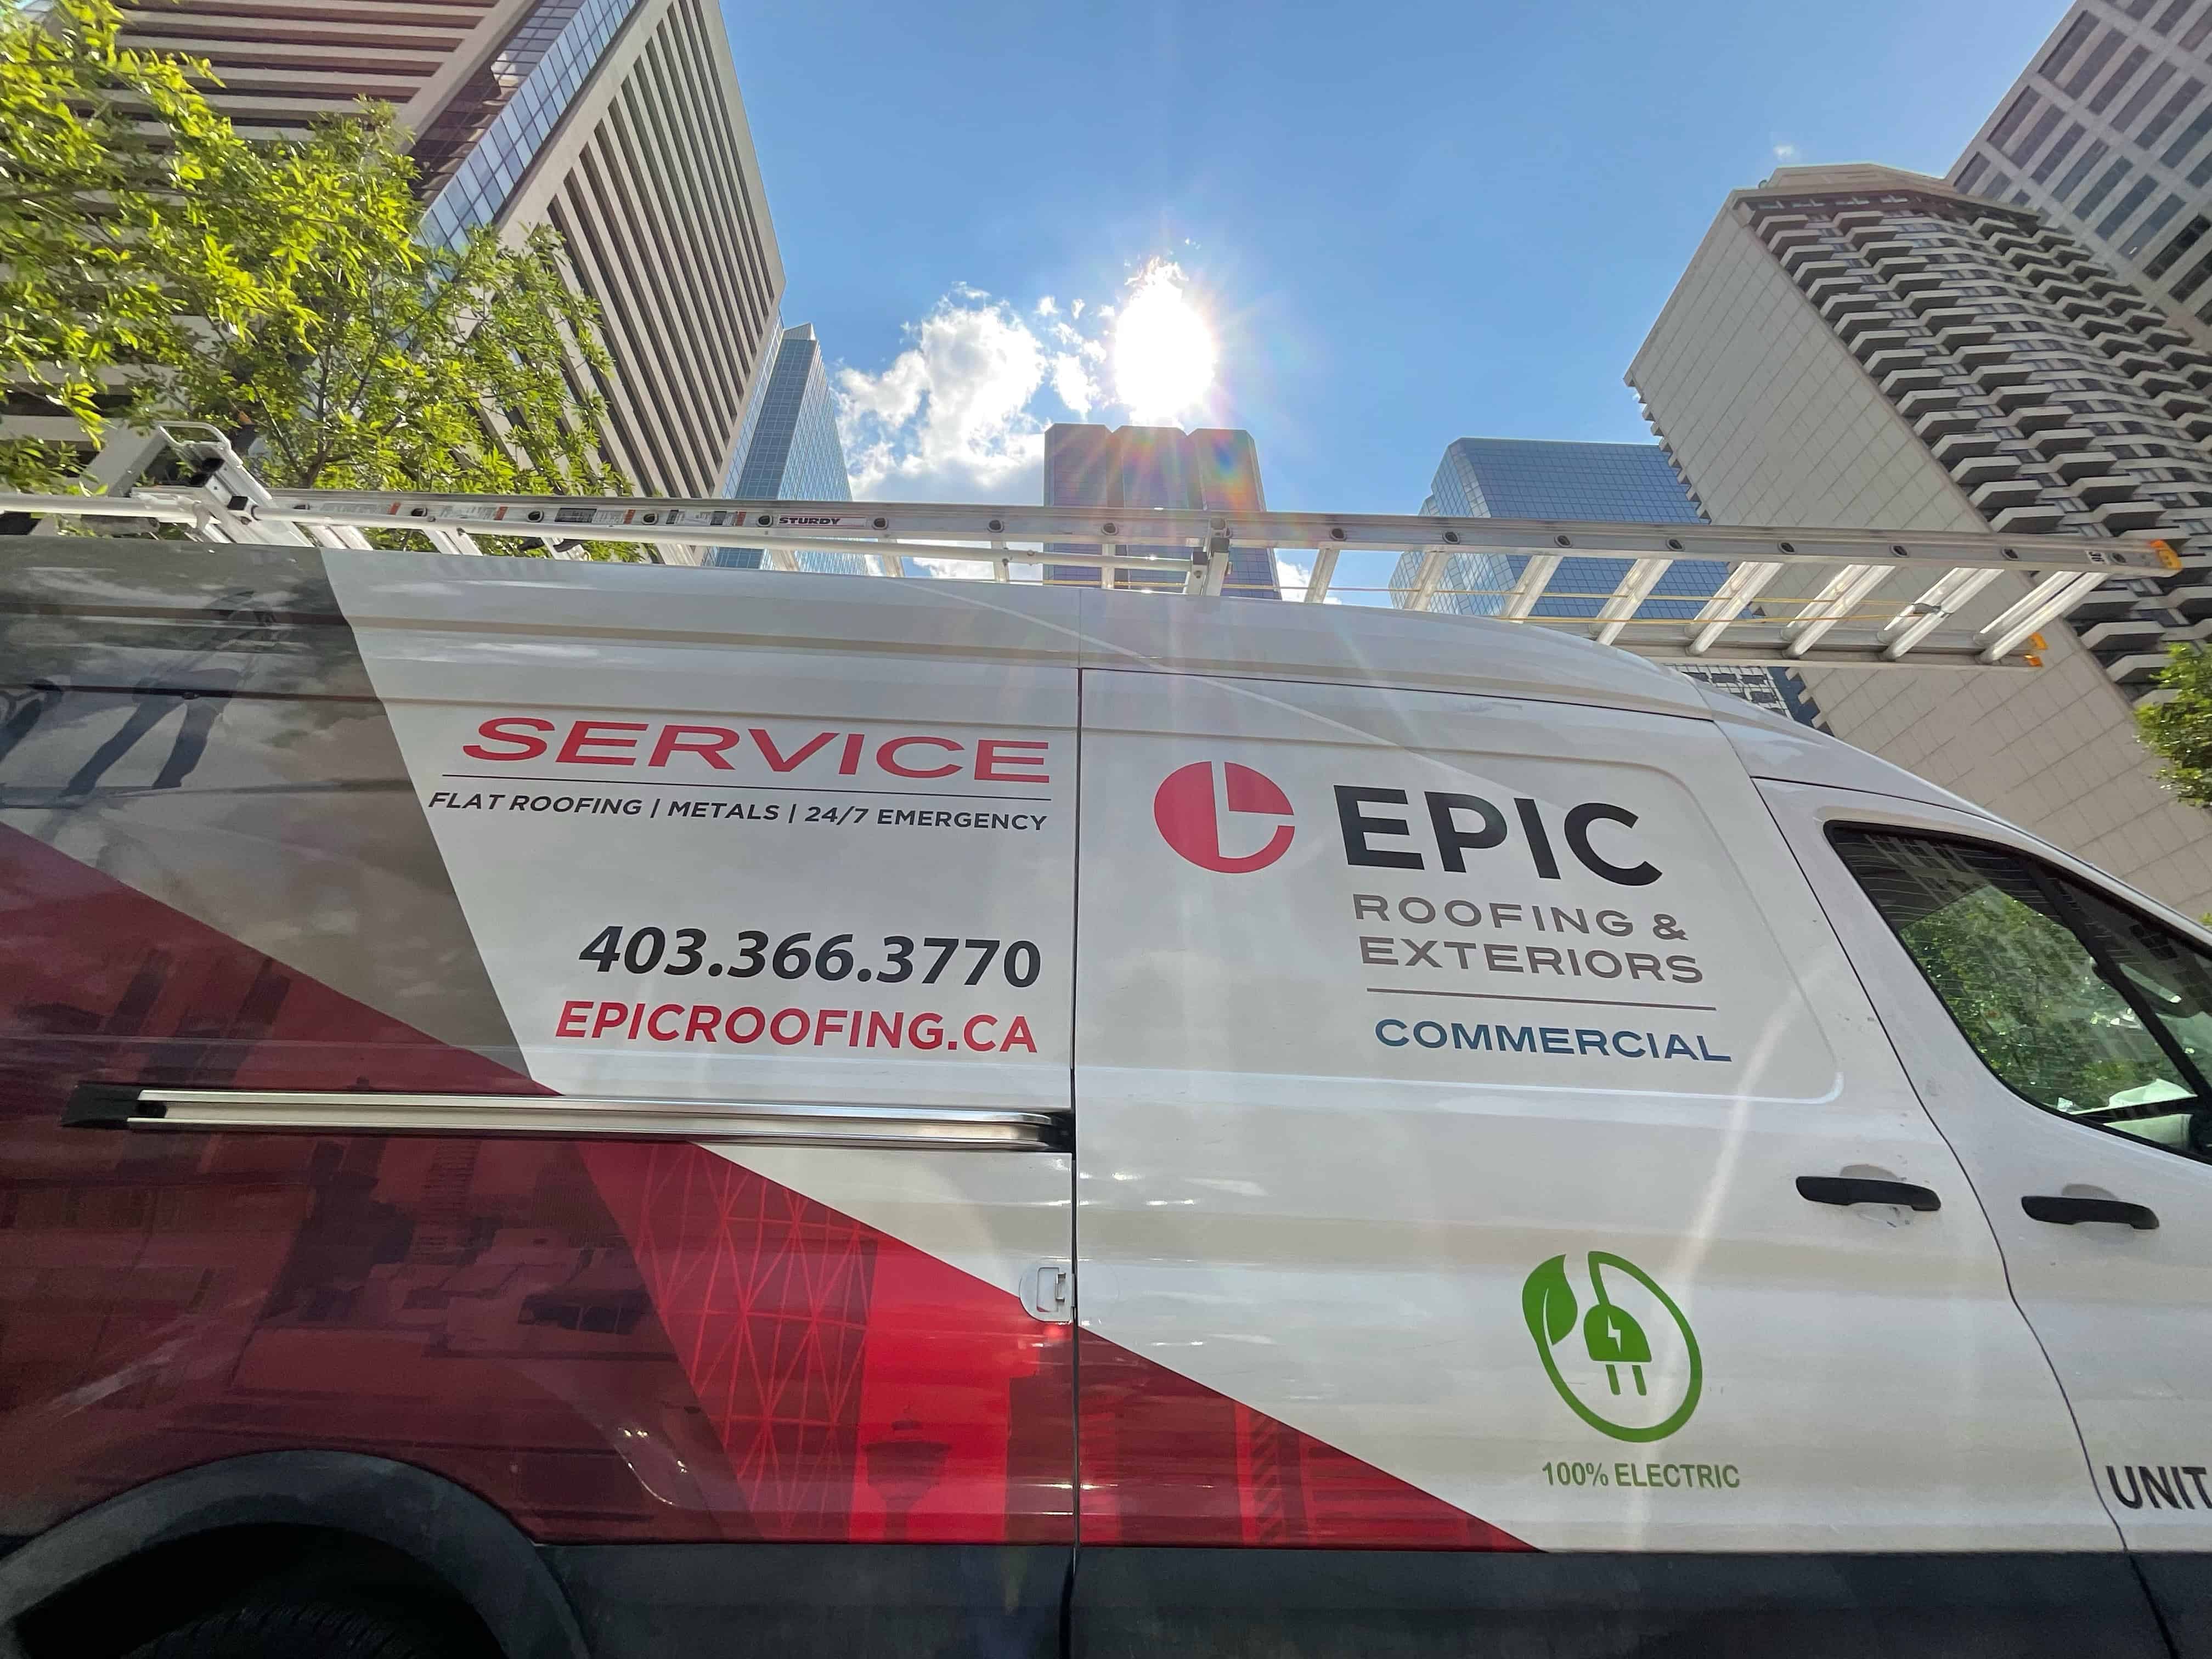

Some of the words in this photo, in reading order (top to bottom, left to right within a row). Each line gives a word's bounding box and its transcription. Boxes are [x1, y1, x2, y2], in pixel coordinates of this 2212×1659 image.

[778, 517, 841, 525] STURDY
[462, 717, 1049, 783] SERVICE
[428, 792, 506, 810] FLAT
[509, 795, 642, 815] ROOFING
[667, 801, 780, 820] METALS
[804, 806, 869, 826] 24/7
[877, 809, 1047, 831] EMERGENCY
[1333, 785, 1663, 887] EPIC
[1352, 894, 1633, 937] ROOFING
[1652, 913, 1689, 941] &
[578, 926, 1041, 988] 403.366.3770
[1359, 936, 1703, 984] EXTERIORS
[555, 1000, 1037, 1053] EPICROOFING.CA
[1375, 1019, 1732, 1062] COMMERCIAL
[1542, 1462, 1609, 1486] 100%
[1614, 1463, 1740, 1488] ELECTRIC
[2105, 1465, 2212, 1510] UNIT
